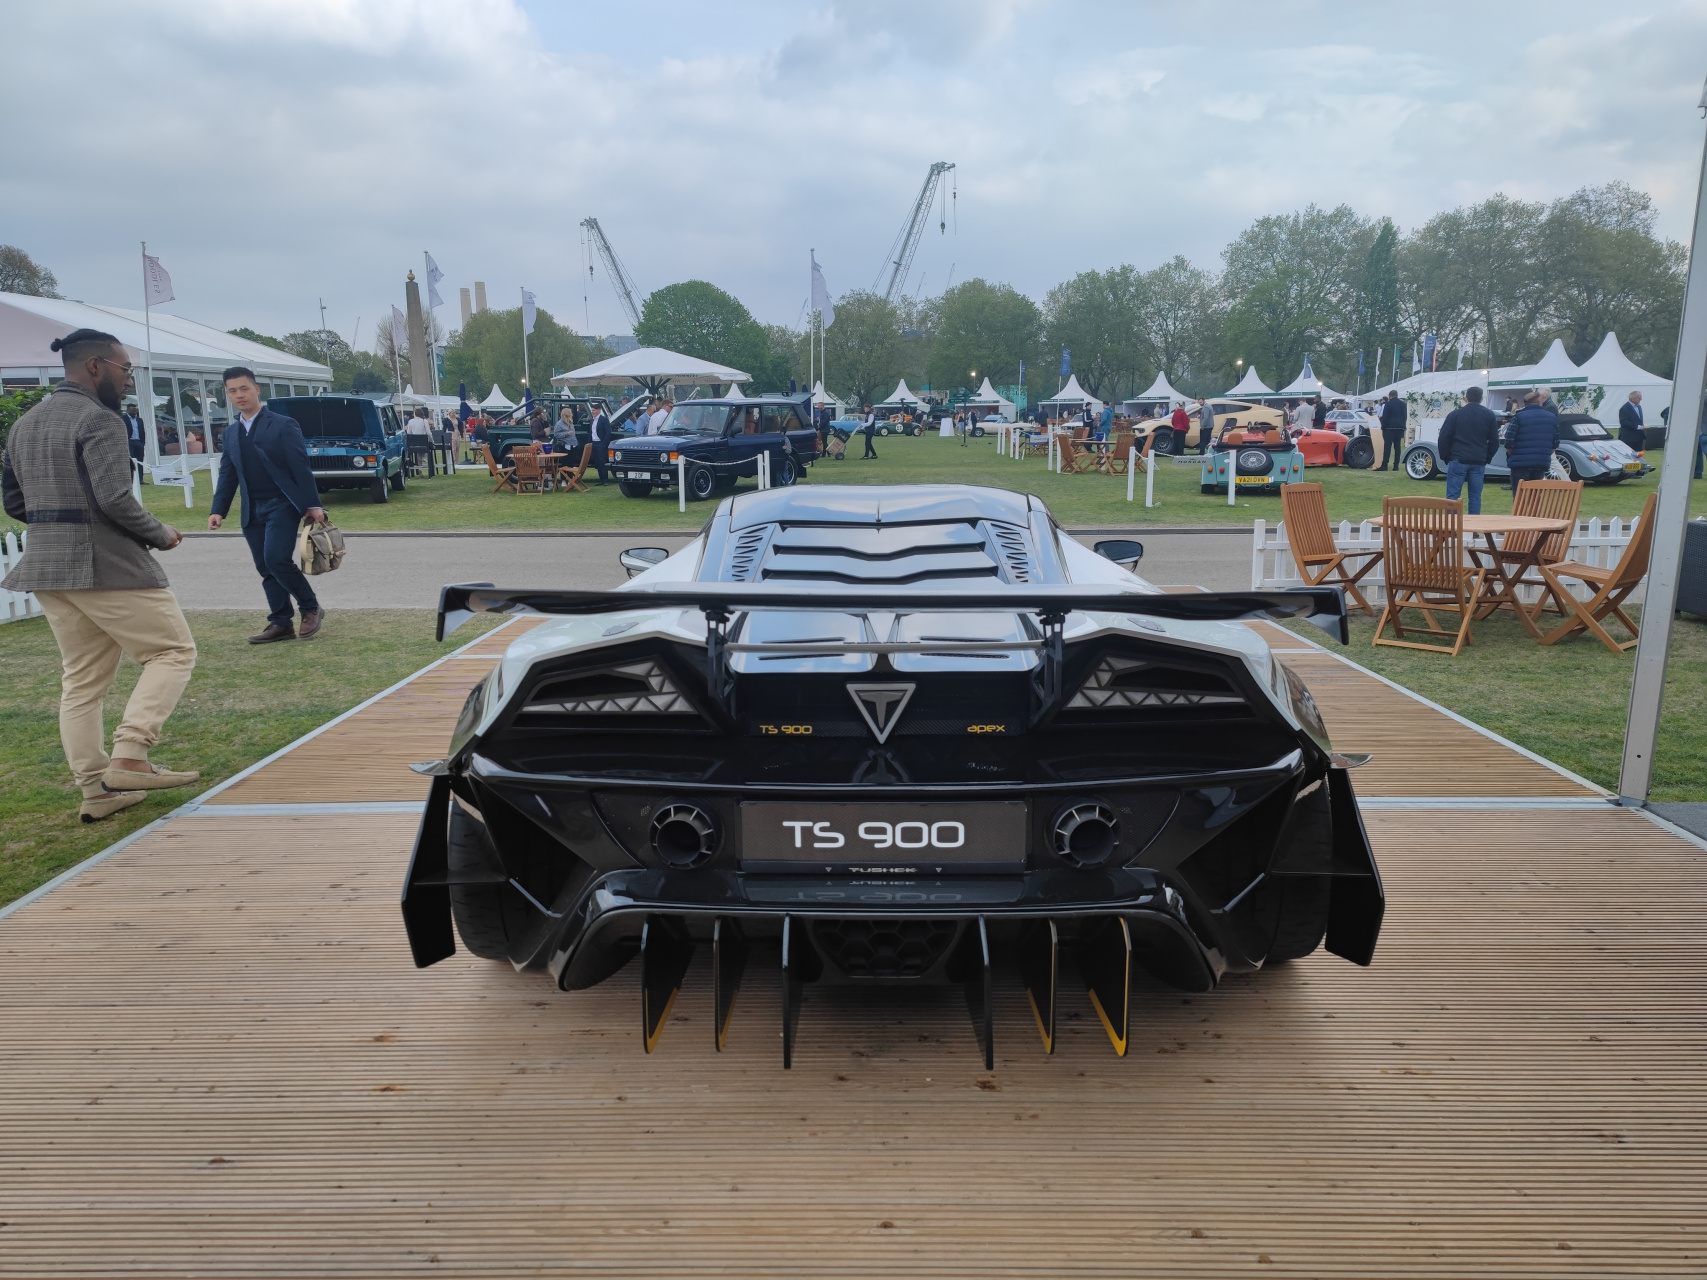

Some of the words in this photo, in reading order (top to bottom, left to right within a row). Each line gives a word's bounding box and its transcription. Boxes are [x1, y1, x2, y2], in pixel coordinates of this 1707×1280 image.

[759, 725, 779, 734] TS
[781, 725, 813, 734] 900
[967, 724, 1006, 734] apex
[782, 821, 845, 848] TS
[858, 821, 965, 848] 900
